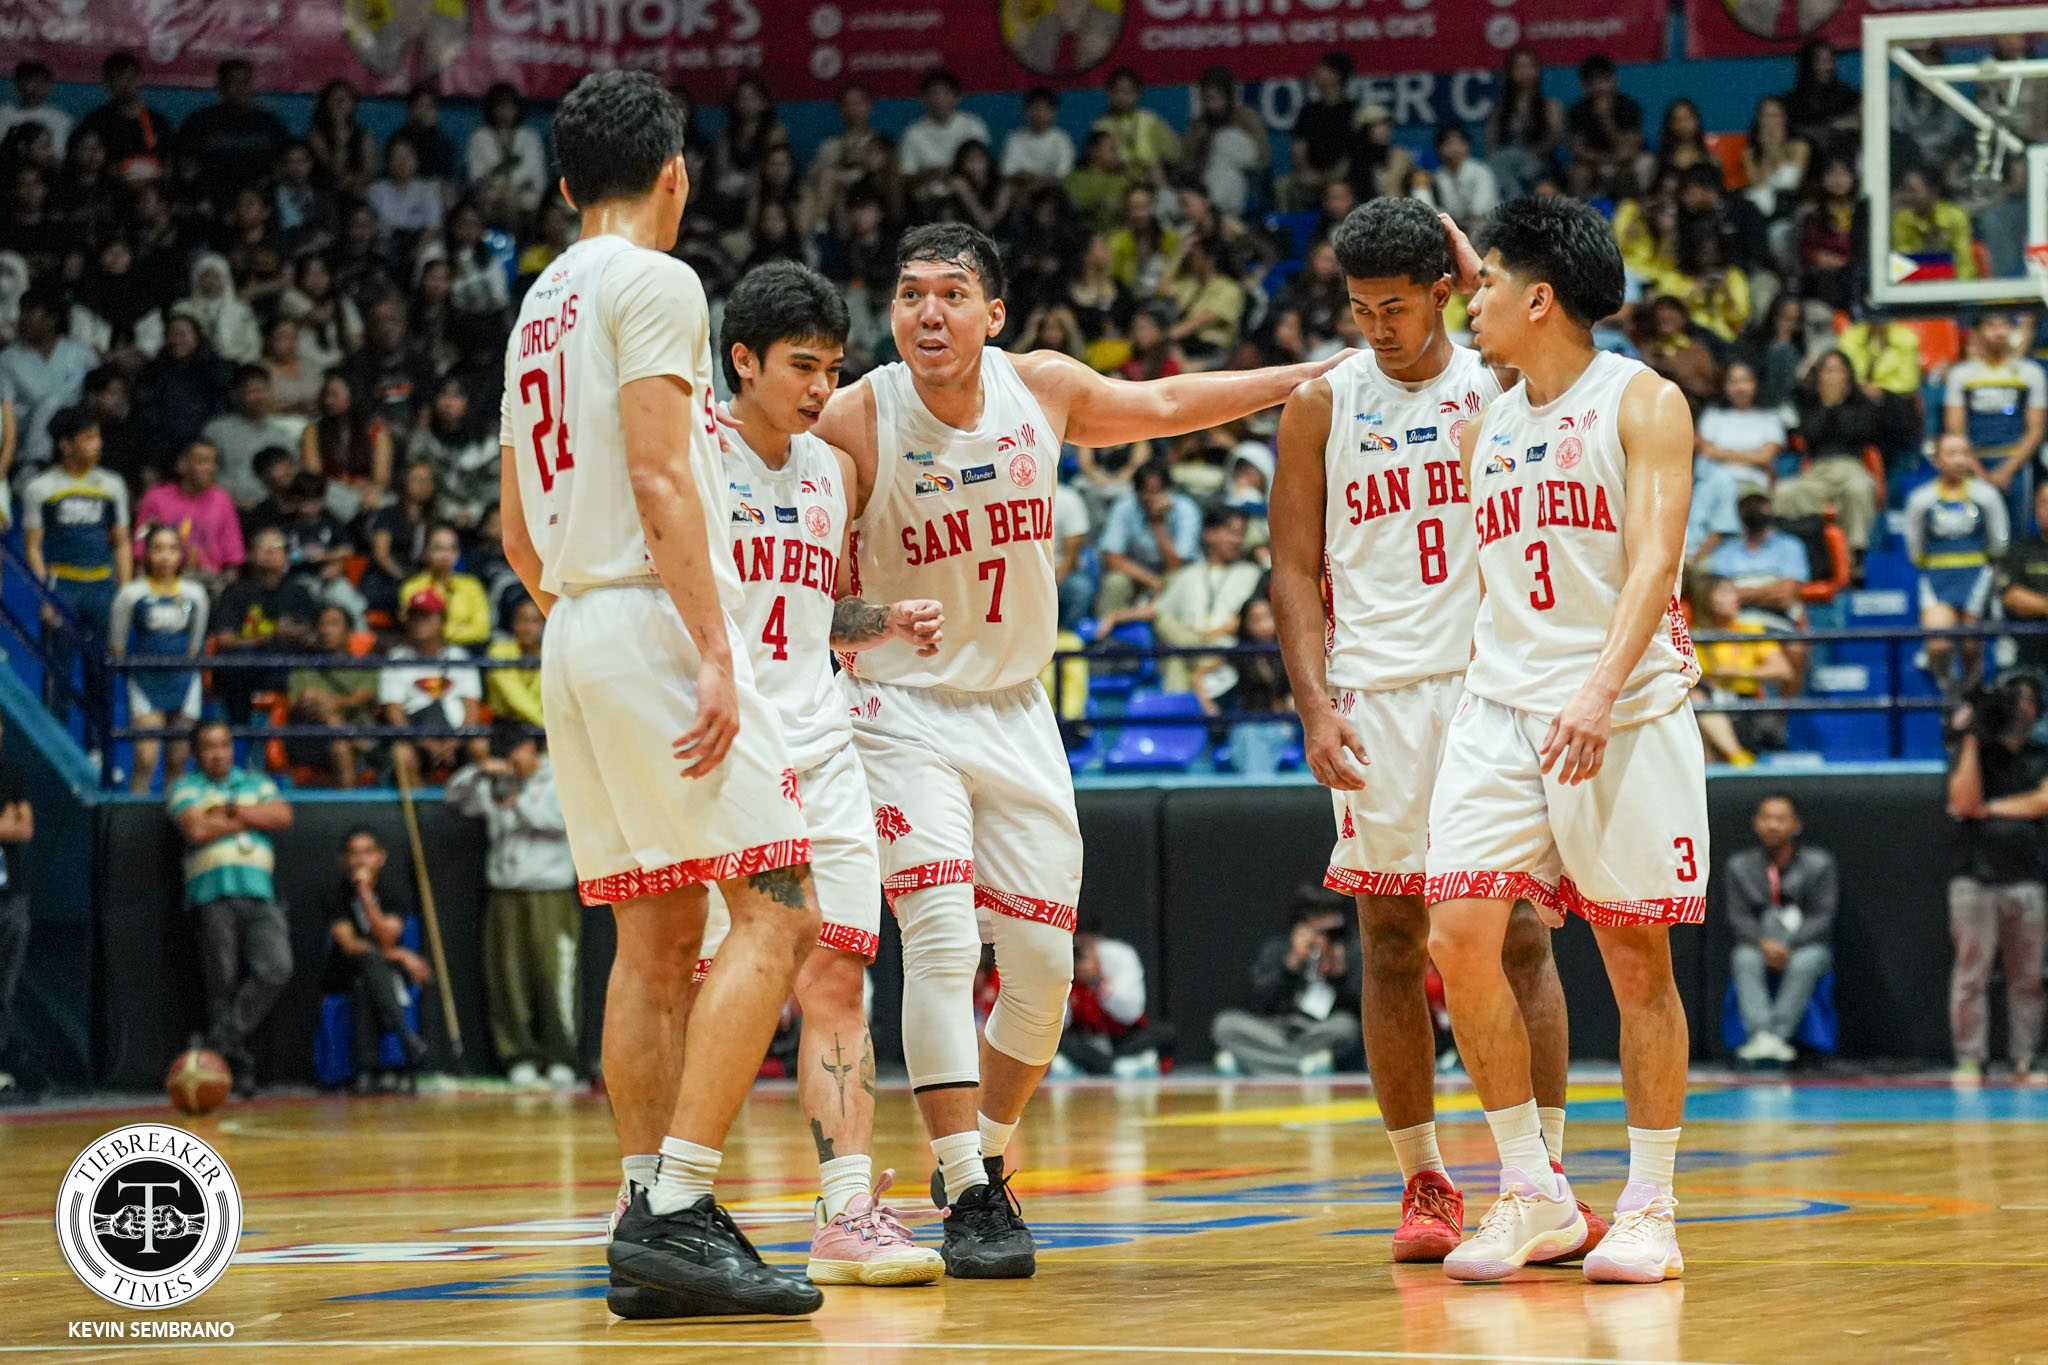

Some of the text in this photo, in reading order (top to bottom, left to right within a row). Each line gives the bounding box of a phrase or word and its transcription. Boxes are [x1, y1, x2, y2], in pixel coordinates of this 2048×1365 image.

[1345, 460, 1471, 526] SAN BE
[1475, 480, 1618, 552] SAN BEDA
[732, 536, 776, 583] AN
[901, 509, 973, 566] SAN
[1416, 517, 1449, 586] 8
[978, 557, 1006, 624] 7
[1524, 540, 1556, 612] 3
[761, 595, 788, 661] 4
[1672, 836, 1698, 883] 3
